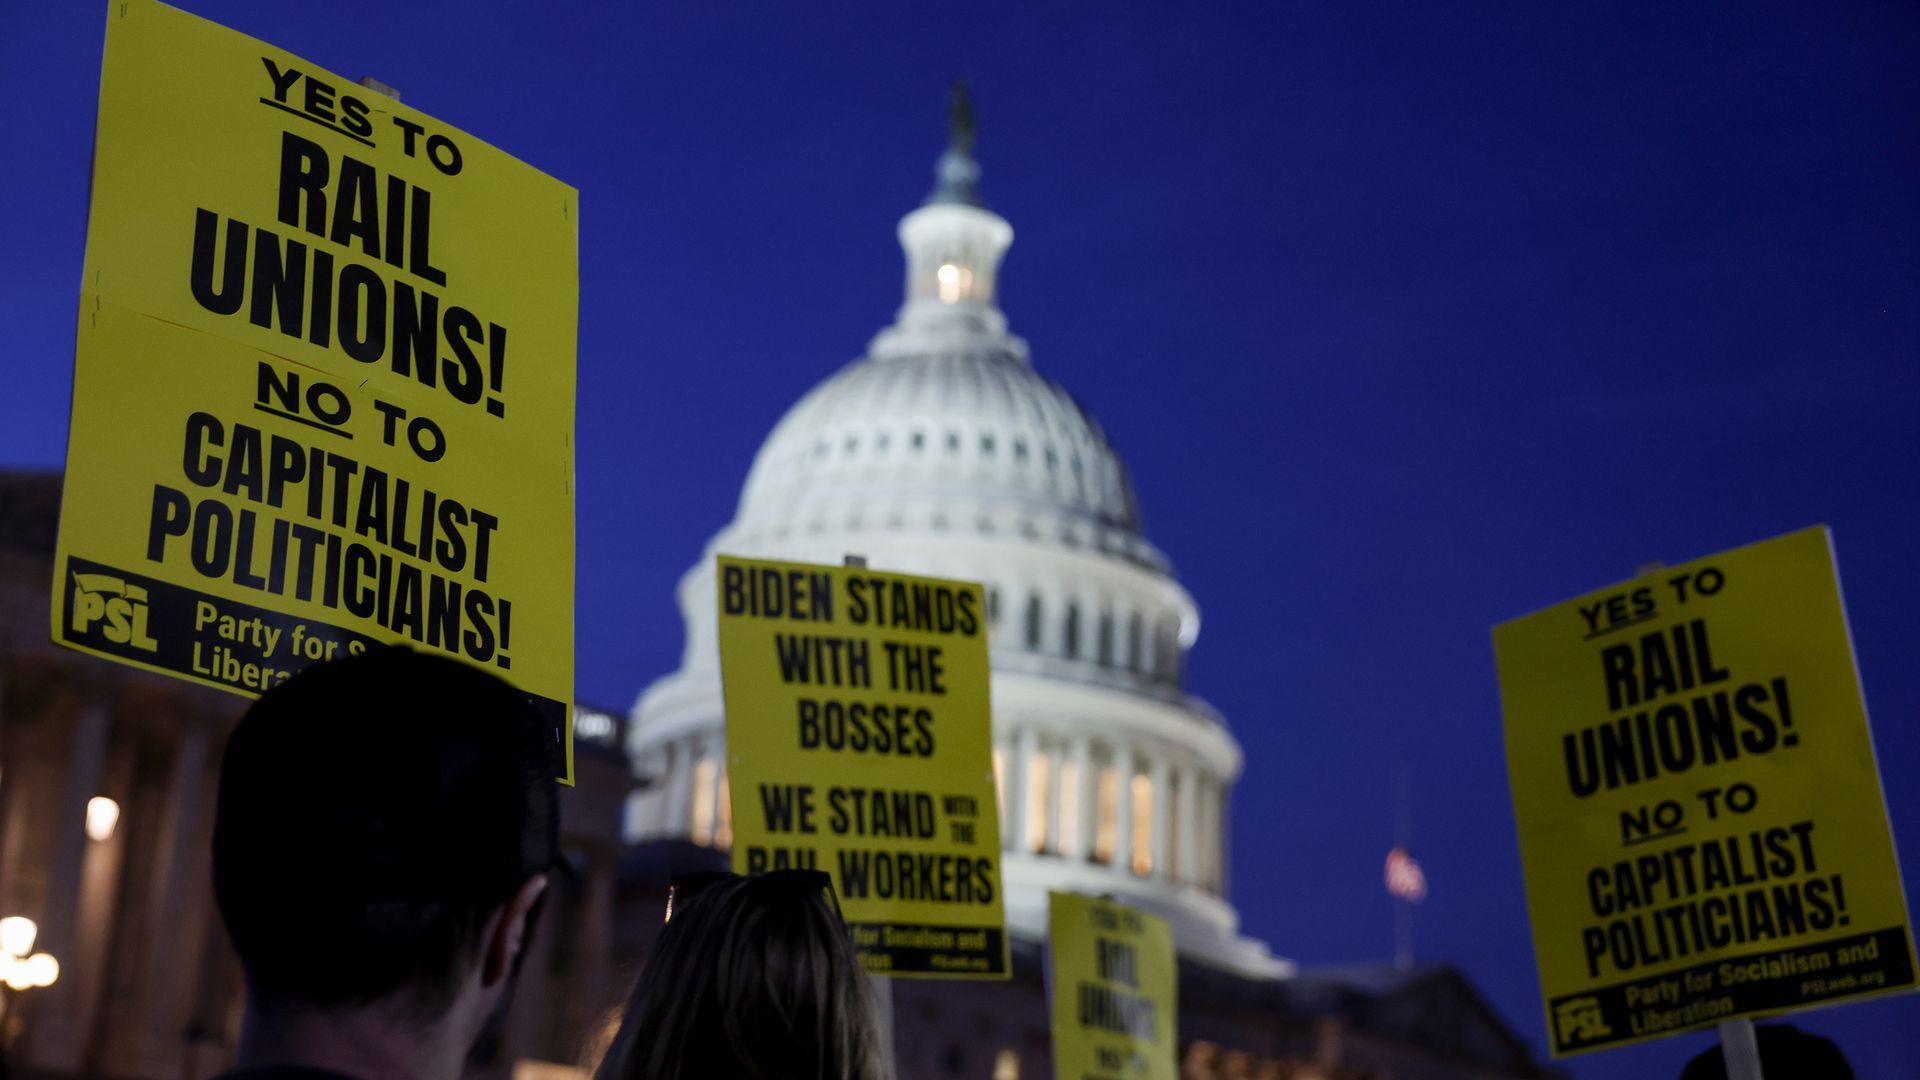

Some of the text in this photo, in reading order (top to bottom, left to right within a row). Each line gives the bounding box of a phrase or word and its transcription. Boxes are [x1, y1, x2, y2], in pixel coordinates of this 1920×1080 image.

[261, 57, 463, 176] YES TO
[277, 130, 446, 287] RAIL
[190, 207, 506, 418] UNIONS!
[256, 362, 446, 462] NO TO
[183, 412, 498, 583] CAPITALIST
[147, 484, 511, 670] POLITICIANS!
[723, 564, 978, 637] BIDEN STANDS
[1579, 567, 1725, 635] YES TO
[72, 584, 158, 652] PSL
[195, 601, 338, 662] Party for
[193, 641, 292, 690] Liber
[775, 633, 946, 695] WITH THE
[1602, 618, 1729, 713] RAIL
[798, 697, 935, 758] BOSSES
[1562, 676, 1800, 798] UNIONS!
[759, 783, 978, 839] WE STAND WITH
[951, 821, 975, 844] THE
[1620, 783, 1757, 840] NO TO
[837, 849, 993, 905] WORKERS
[1587, 820, 1817, 917] CAPITALIST
[1582, 873, 1850, 979] POLITICIANS!
[1625, 938, 1879, 1009] Party for Socialism and
[1630, 998, 1734, 1036] Liberation
